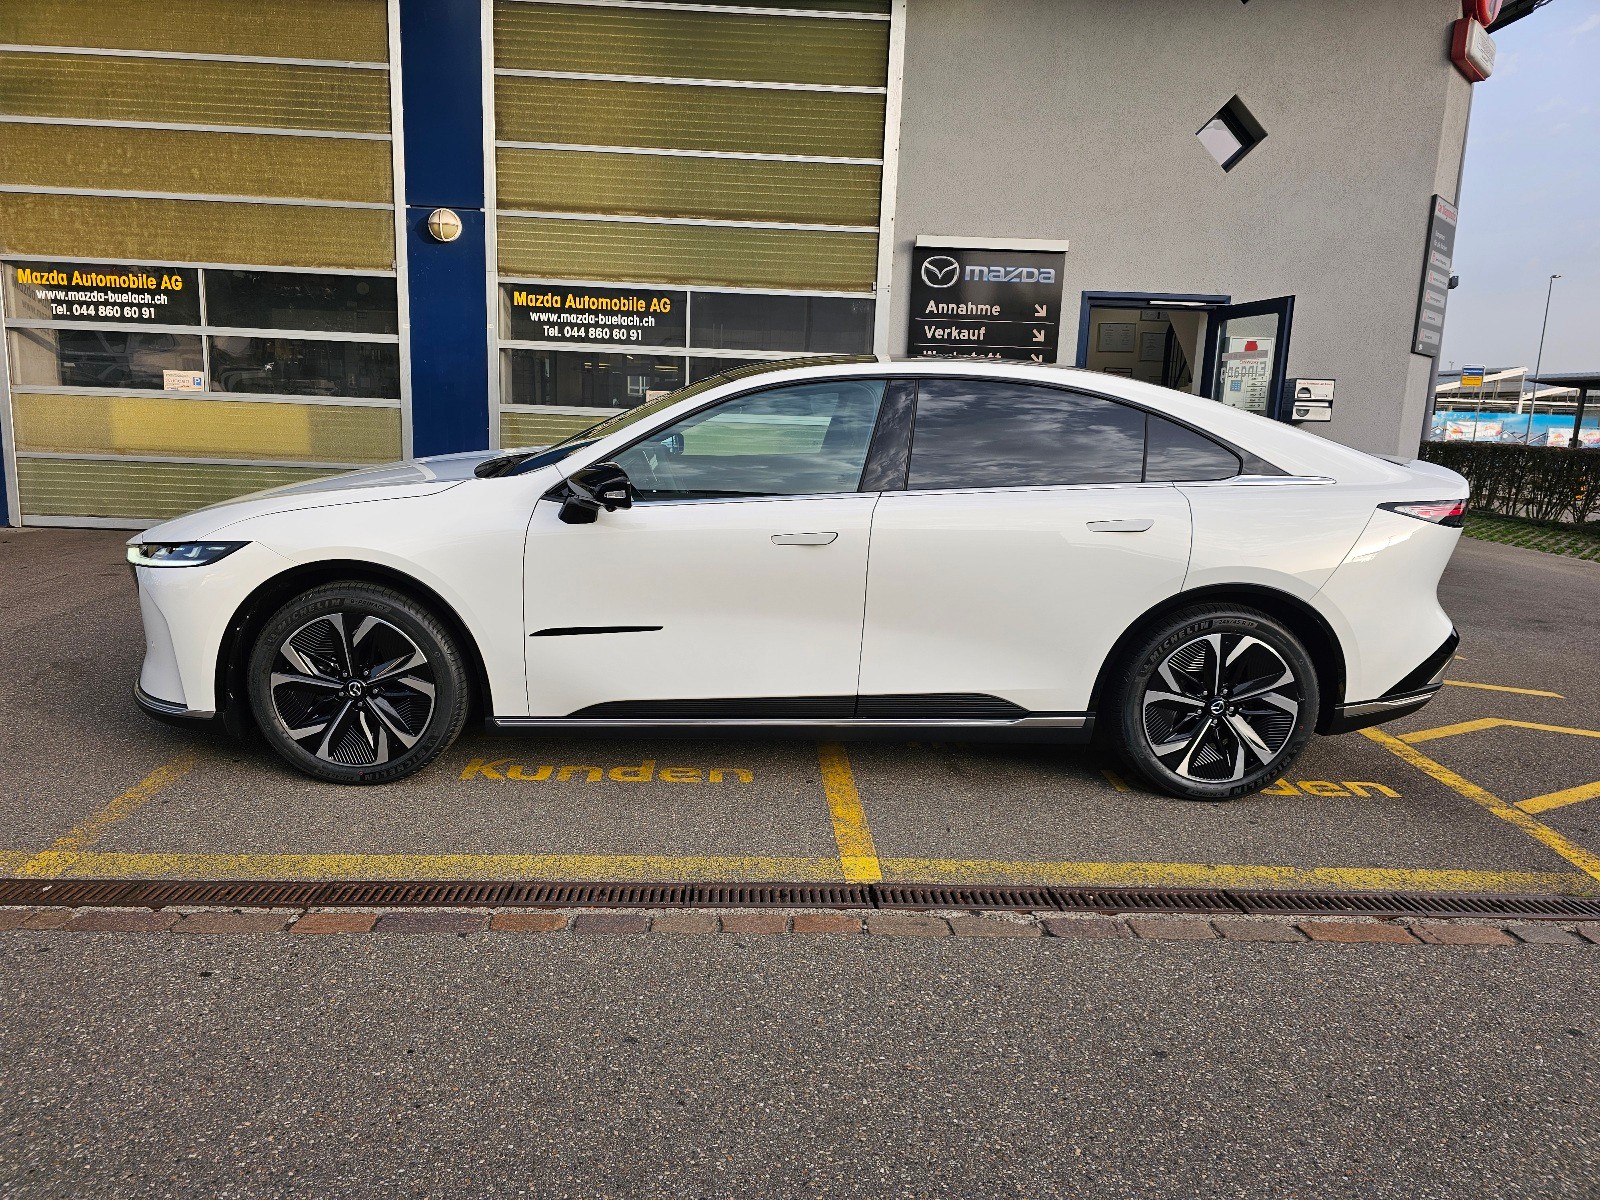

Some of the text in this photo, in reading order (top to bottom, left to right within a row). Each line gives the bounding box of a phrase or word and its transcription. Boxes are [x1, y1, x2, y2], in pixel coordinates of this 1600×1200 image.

[17, 268, 183, 290] Mazda Automobile AG
[36, 289, 168, 305] www.mazda-buelach.ch
[513, 291, 671, 313] Mazda Automobile AG
[51, 303, 155, 319] Tel. 044 860 60 91
[925, 300, 1000, 316] Annahme
[529, 311, 655, 327] www.mazda-buelach.ch
[543, 325, 642, 341] Tel. 044 860 60 91
[924, 325, 986, 341] Verkauf
[1149, 620, 1210, 663] MICHELIN
[458, 758, 753, 783] Kunden
[1259, 777, 1403, 798] den
